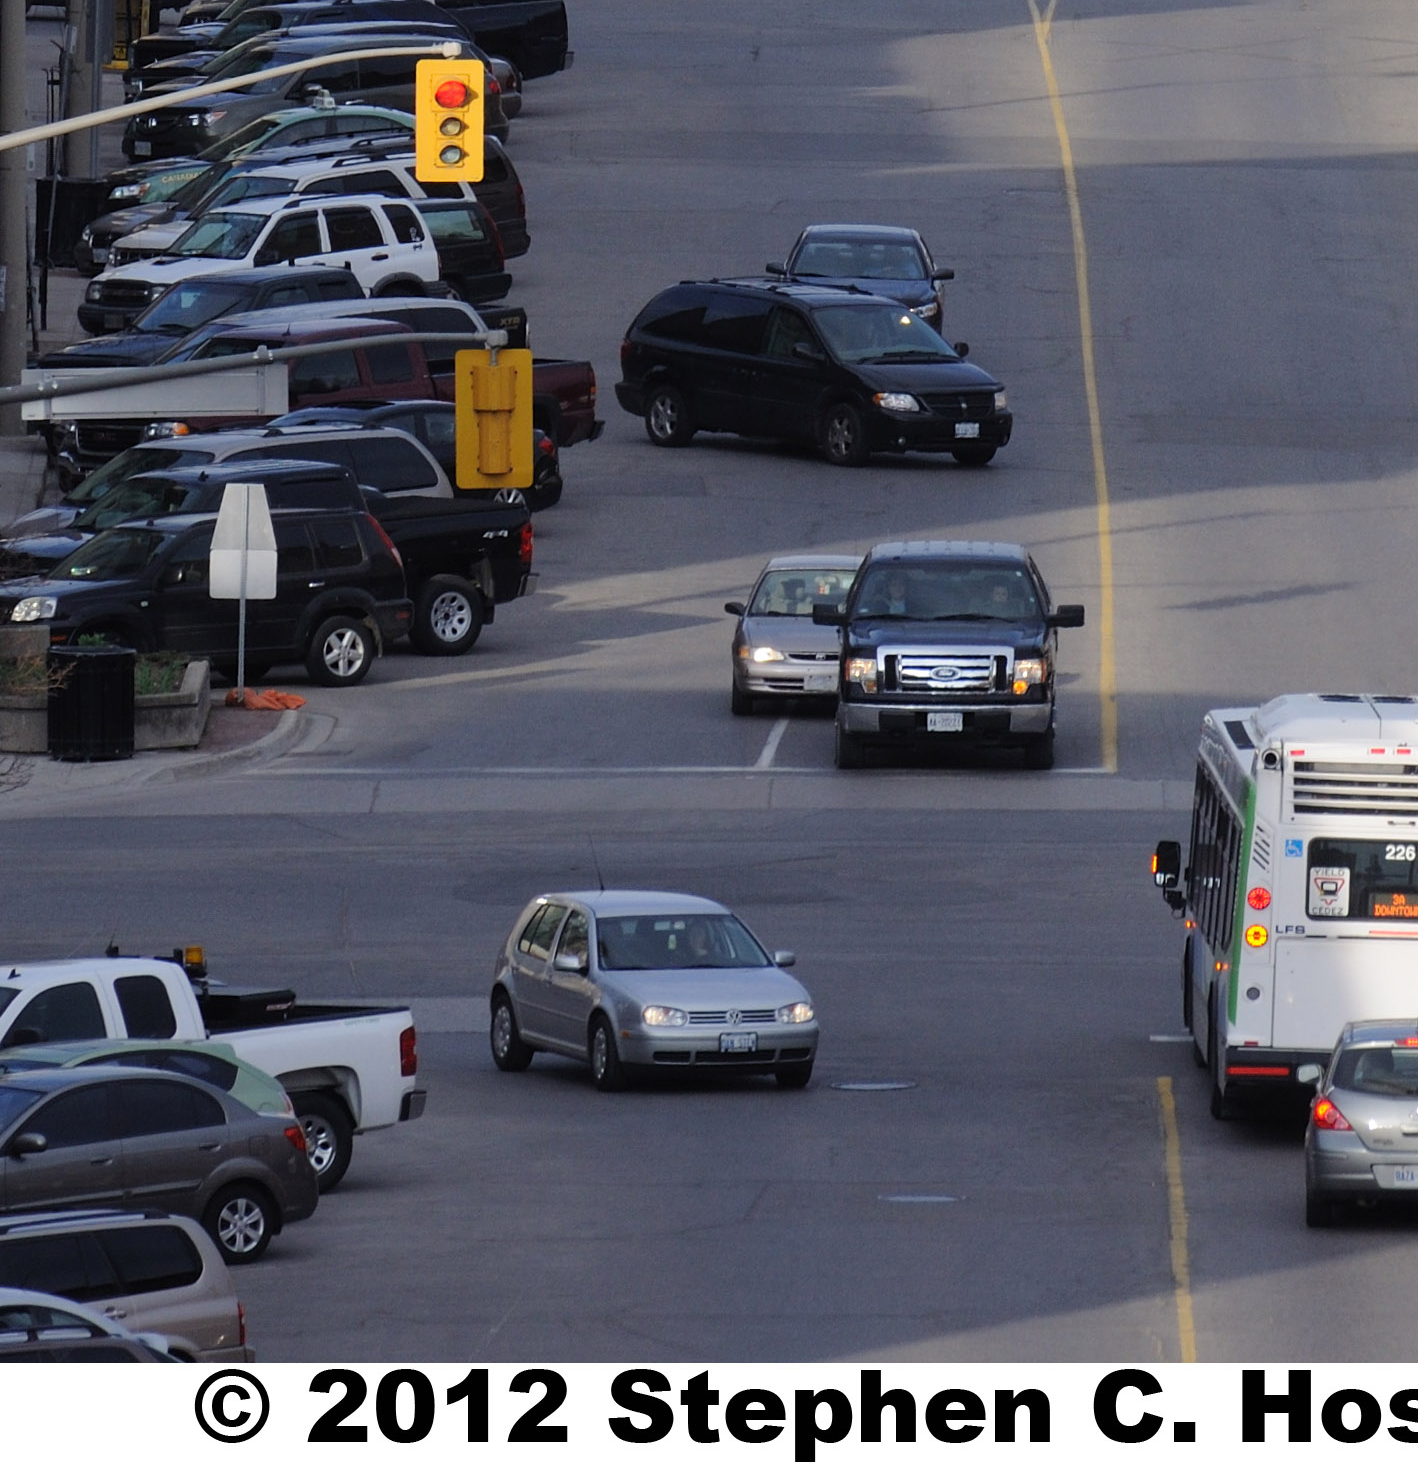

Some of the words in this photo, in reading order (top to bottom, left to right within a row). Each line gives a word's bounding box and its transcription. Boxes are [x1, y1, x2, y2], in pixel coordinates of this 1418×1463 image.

[1385, 844, 1416, 861] 226
[1314, 869, 1345, 877] YIELD
[1392, 894, 1406, 905] 3A
[1275, 925, 1306, 934] LFS
